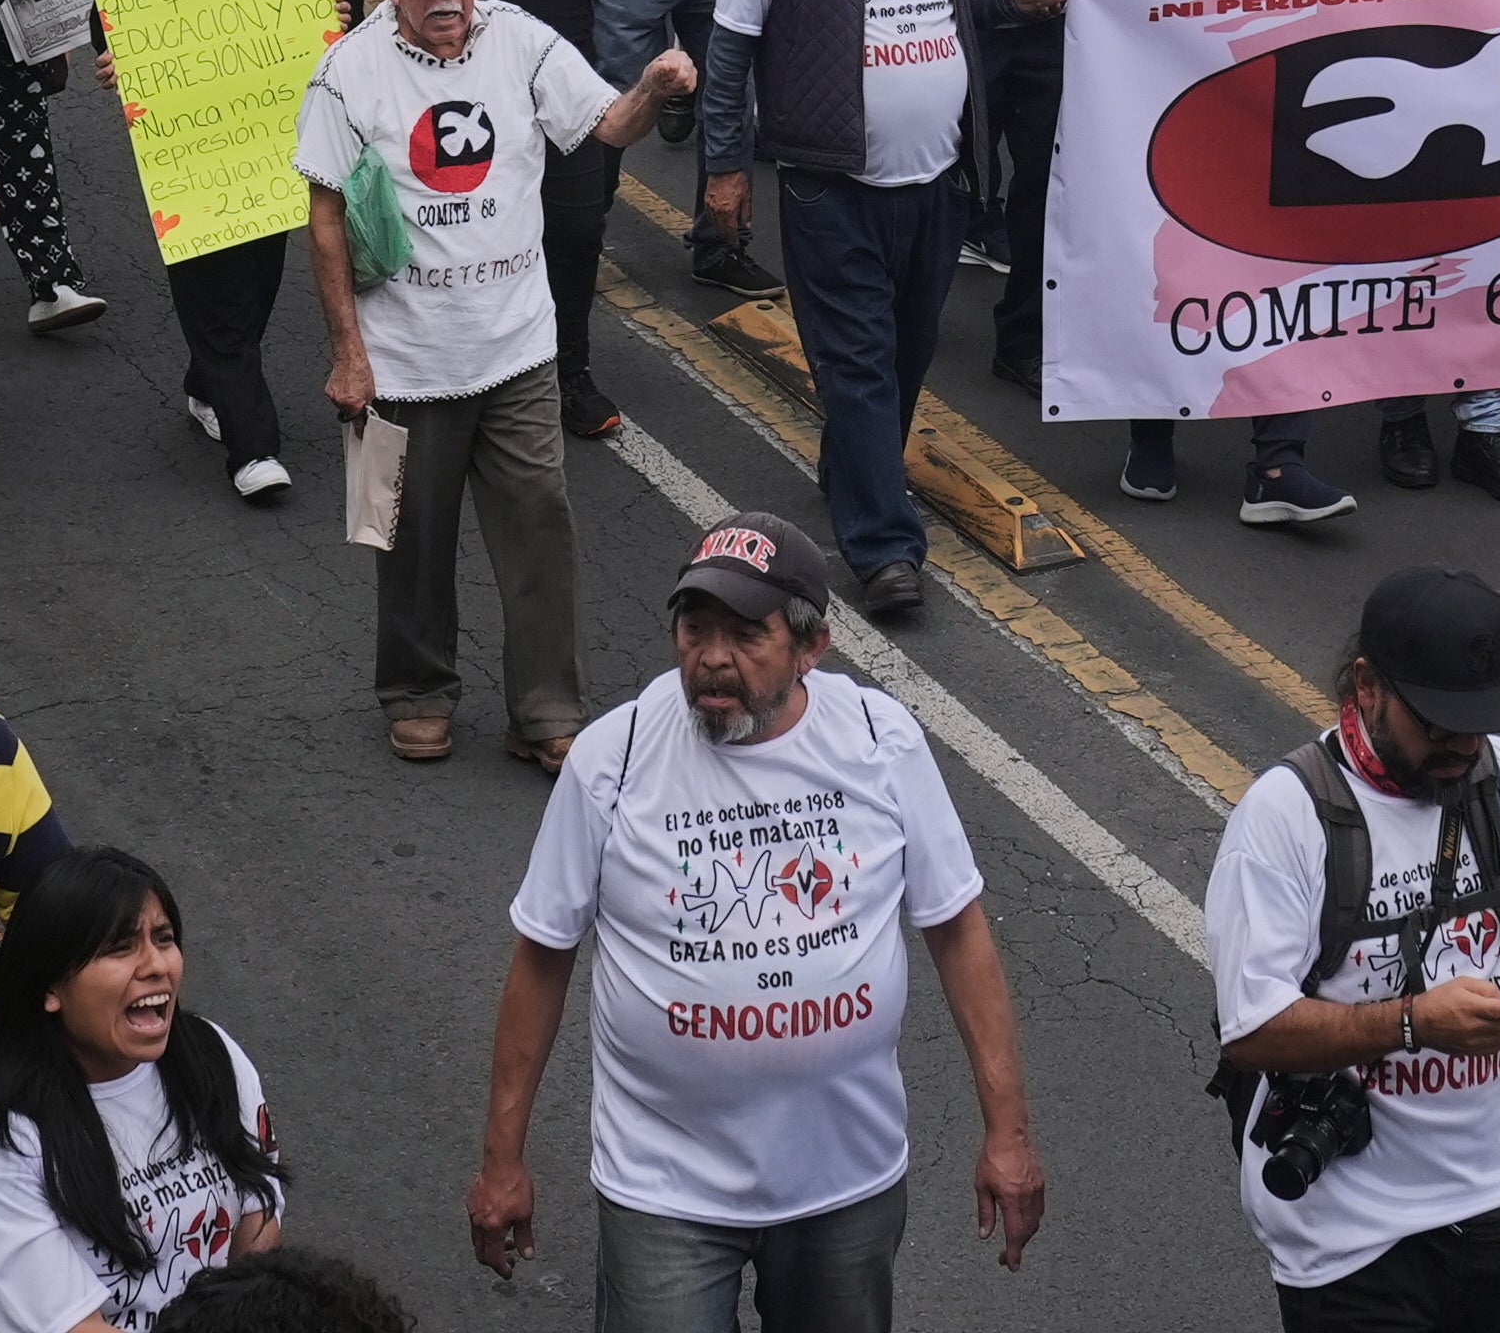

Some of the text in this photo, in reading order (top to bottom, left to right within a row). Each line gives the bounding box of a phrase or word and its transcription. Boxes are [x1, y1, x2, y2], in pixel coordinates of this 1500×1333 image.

[880, 2, 912, 17] no es
[897, 22, 916, 34] son
[228, 79, 296, 116] más
[140, 117, 270, 173] represión
[213, 187, 266, 217] 2 de
[417, 198, 496, 227] COMITÉ 68
[1169, 260, 1441, 360] COMITÉ
[665, 791, 845, 833] El 2 de octubre de 1968
[677, 816, 840, 859] no fue matanza
[1379, 870, 1400, 889] de
[1393, 891, 1427, 916] fue
[669, 919, 859, 964] GAZA no es guerra
[756, 969, 794, 991] son
[667, 982, 873, 1043] GENOCIDIOS
[122, 1158, 176, 1190] octubre
